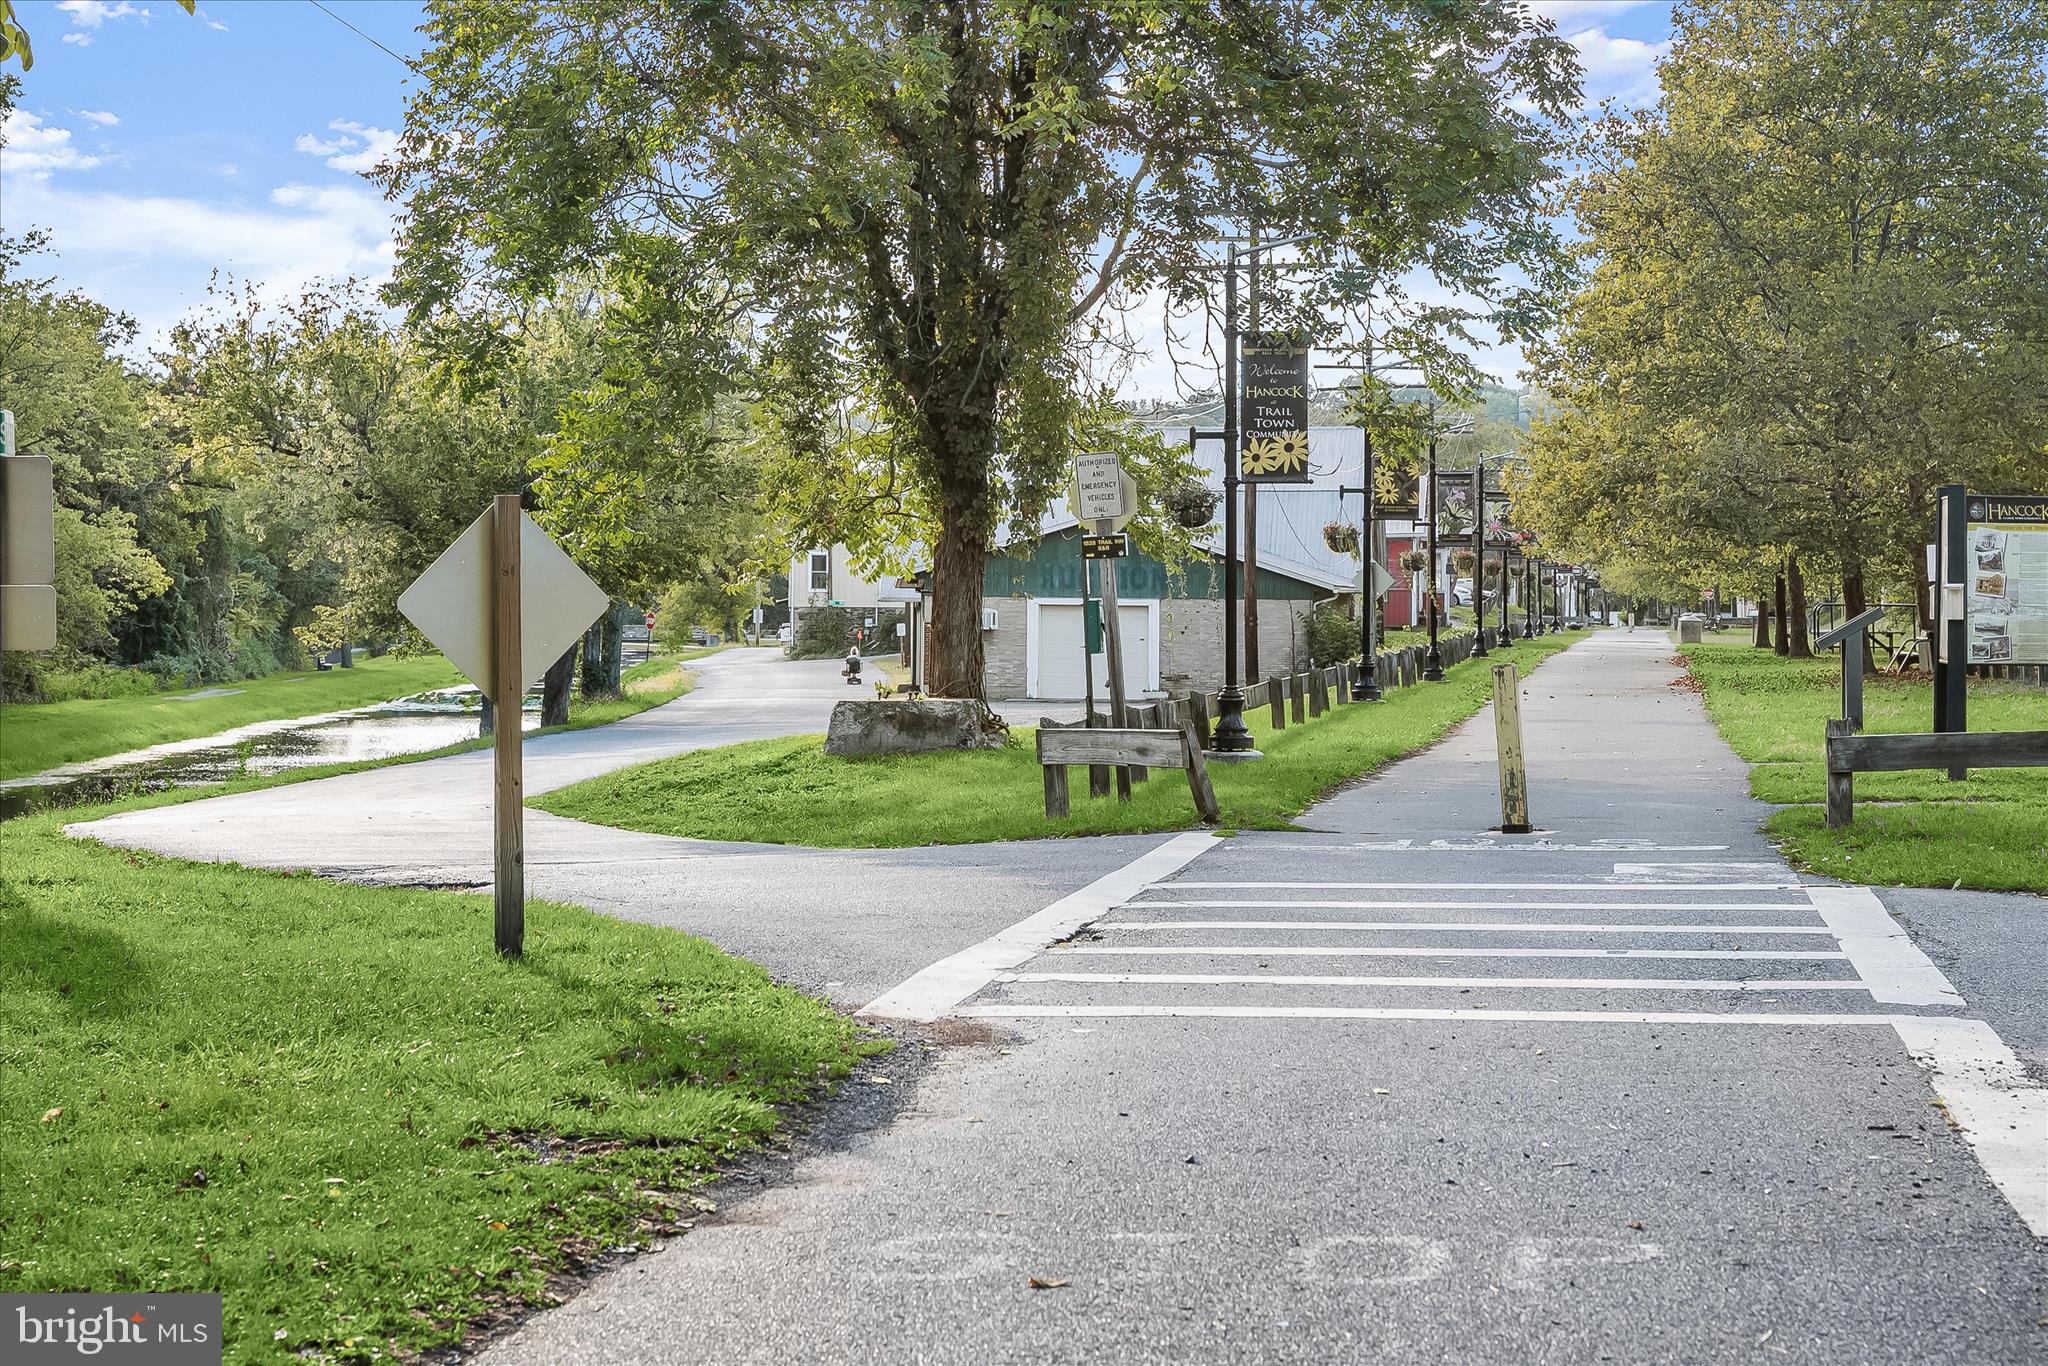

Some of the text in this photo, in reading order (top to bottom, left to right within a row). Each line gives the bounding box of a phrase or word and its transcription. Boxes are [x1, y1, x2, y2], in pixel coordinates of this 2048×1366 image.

[1248, 363, 1300, 377] Welcome
[1246, 385, 1304, 399] HANCOCK
[1256, 406, 1293, 416] TRAIL
[1254, 418, 1295, 428] TOWN
[1078, 457, 1116, 468] AUTHORIZED
[1081, 480, 1117, 491] EMERGENCY
[1087, 493, 1115, 502] VEHICLES
